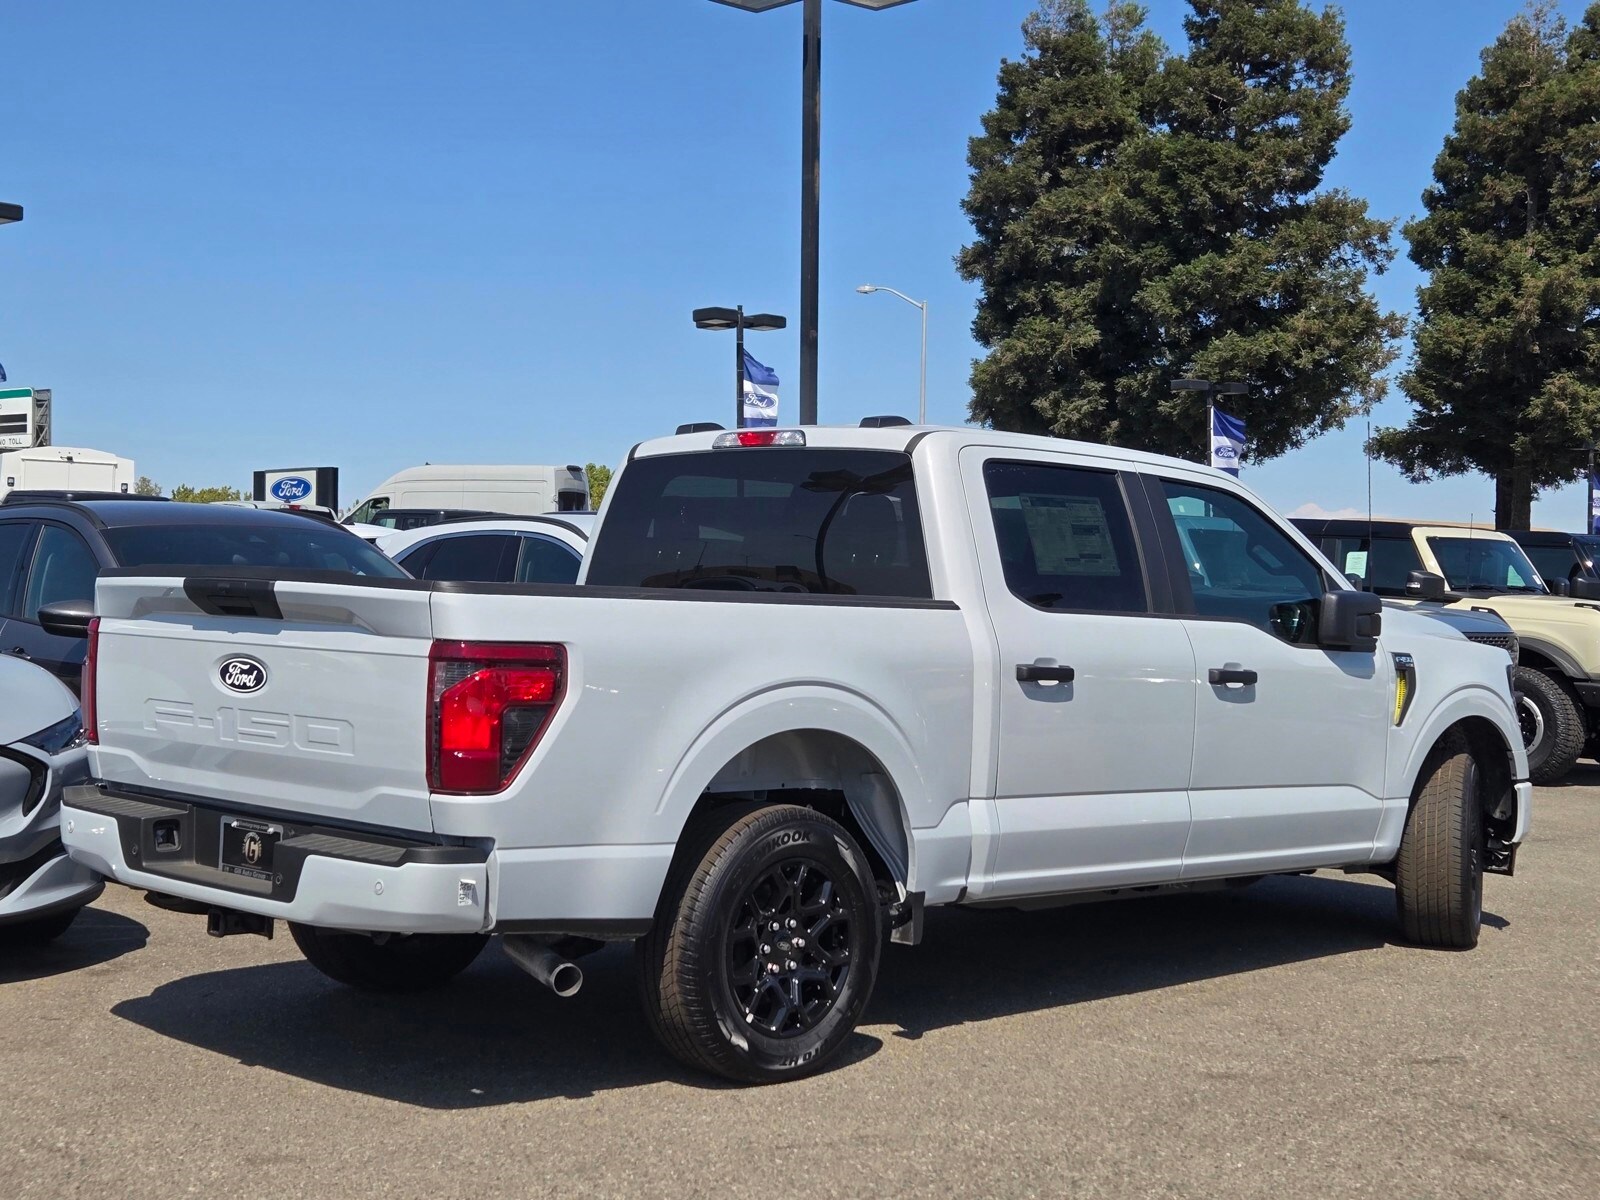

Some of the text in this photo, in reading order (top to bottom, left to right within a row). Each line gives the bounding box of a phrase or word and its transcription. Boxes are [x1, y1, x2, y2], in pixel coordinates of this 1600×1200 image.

[746, 393, 768, 407] Ford
[9, 437, 22, 445] TOLL
[278, 480, 304, 496] Ford
[225, 662, 258, 687] Ford
[144, 698, 355, 757] F-150
